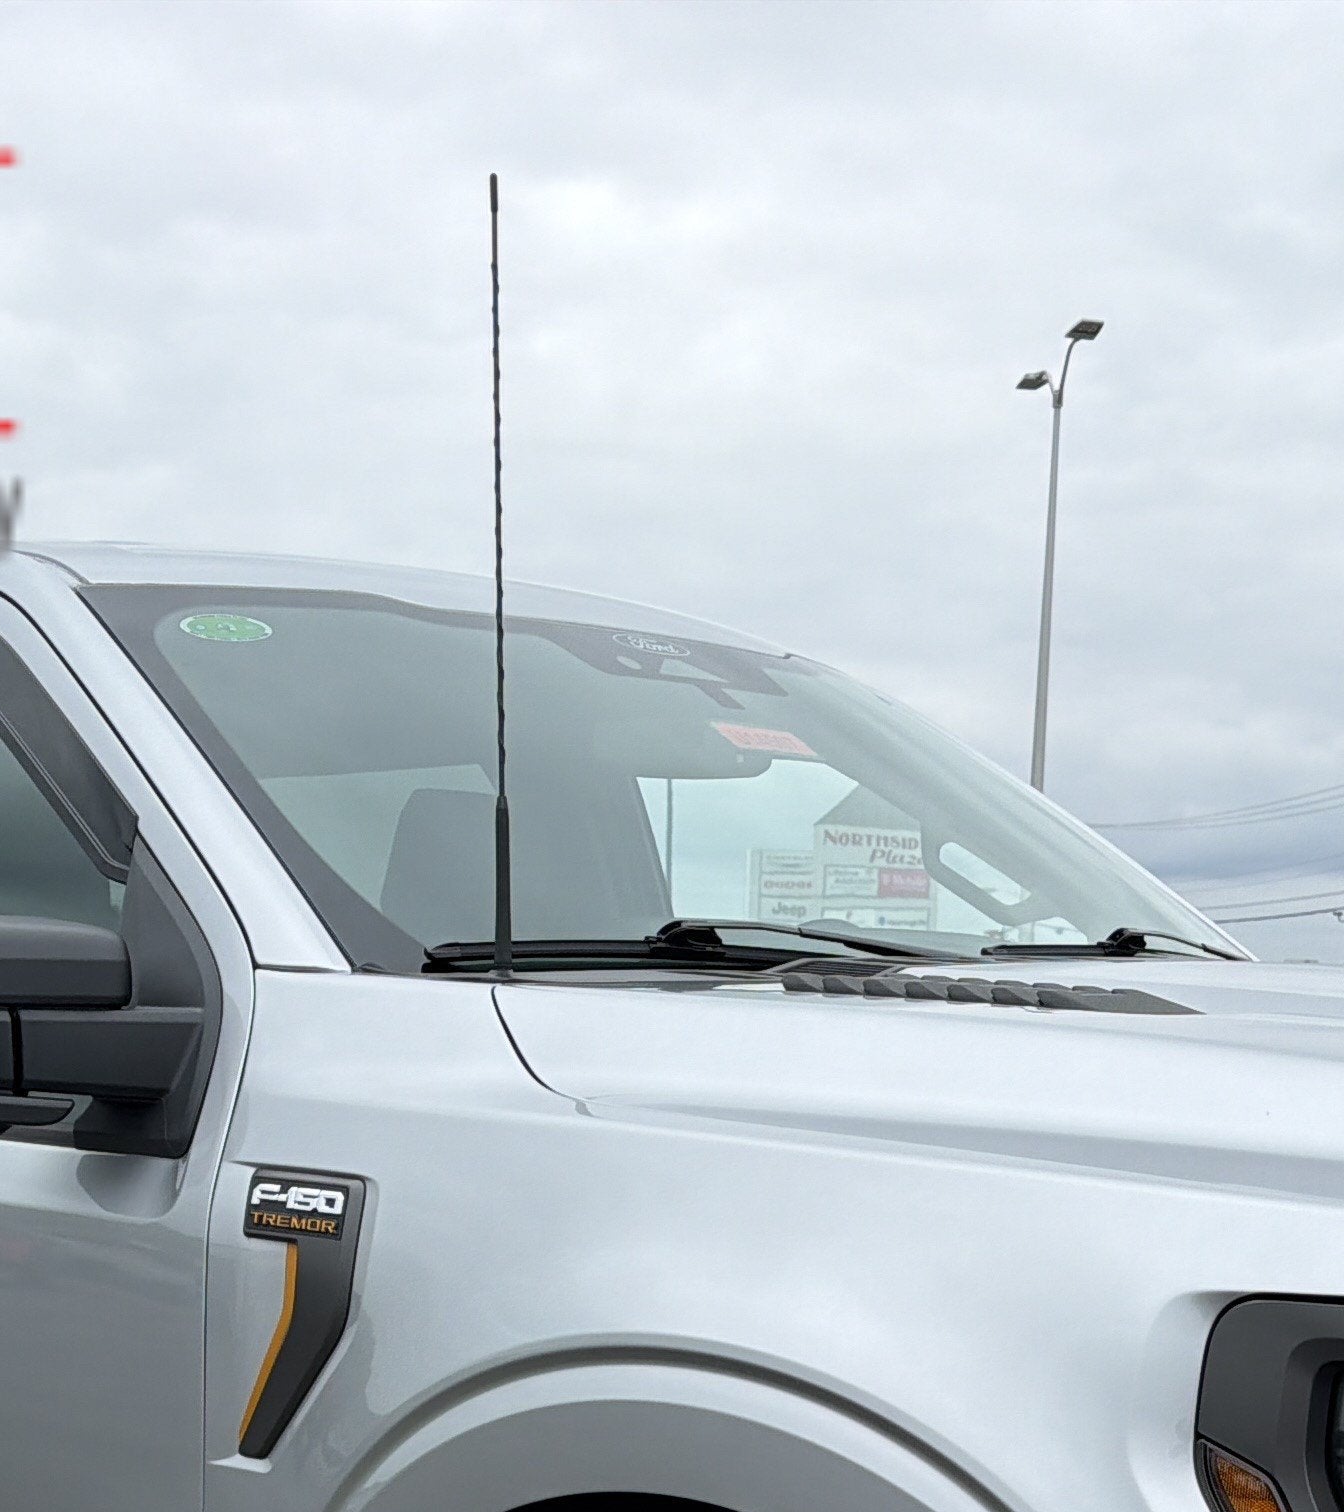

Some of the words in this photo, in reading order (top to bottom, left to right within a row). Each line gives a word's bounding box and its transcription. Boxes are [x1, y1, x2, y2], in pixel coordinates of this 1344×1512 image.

[823, 829, 920, 849] NORTHSID
[771, 901, 807, 918] Jeep
[250, 1183, 345, 1215] F-150
[250, 1210, 337, 1234] TREMOR
